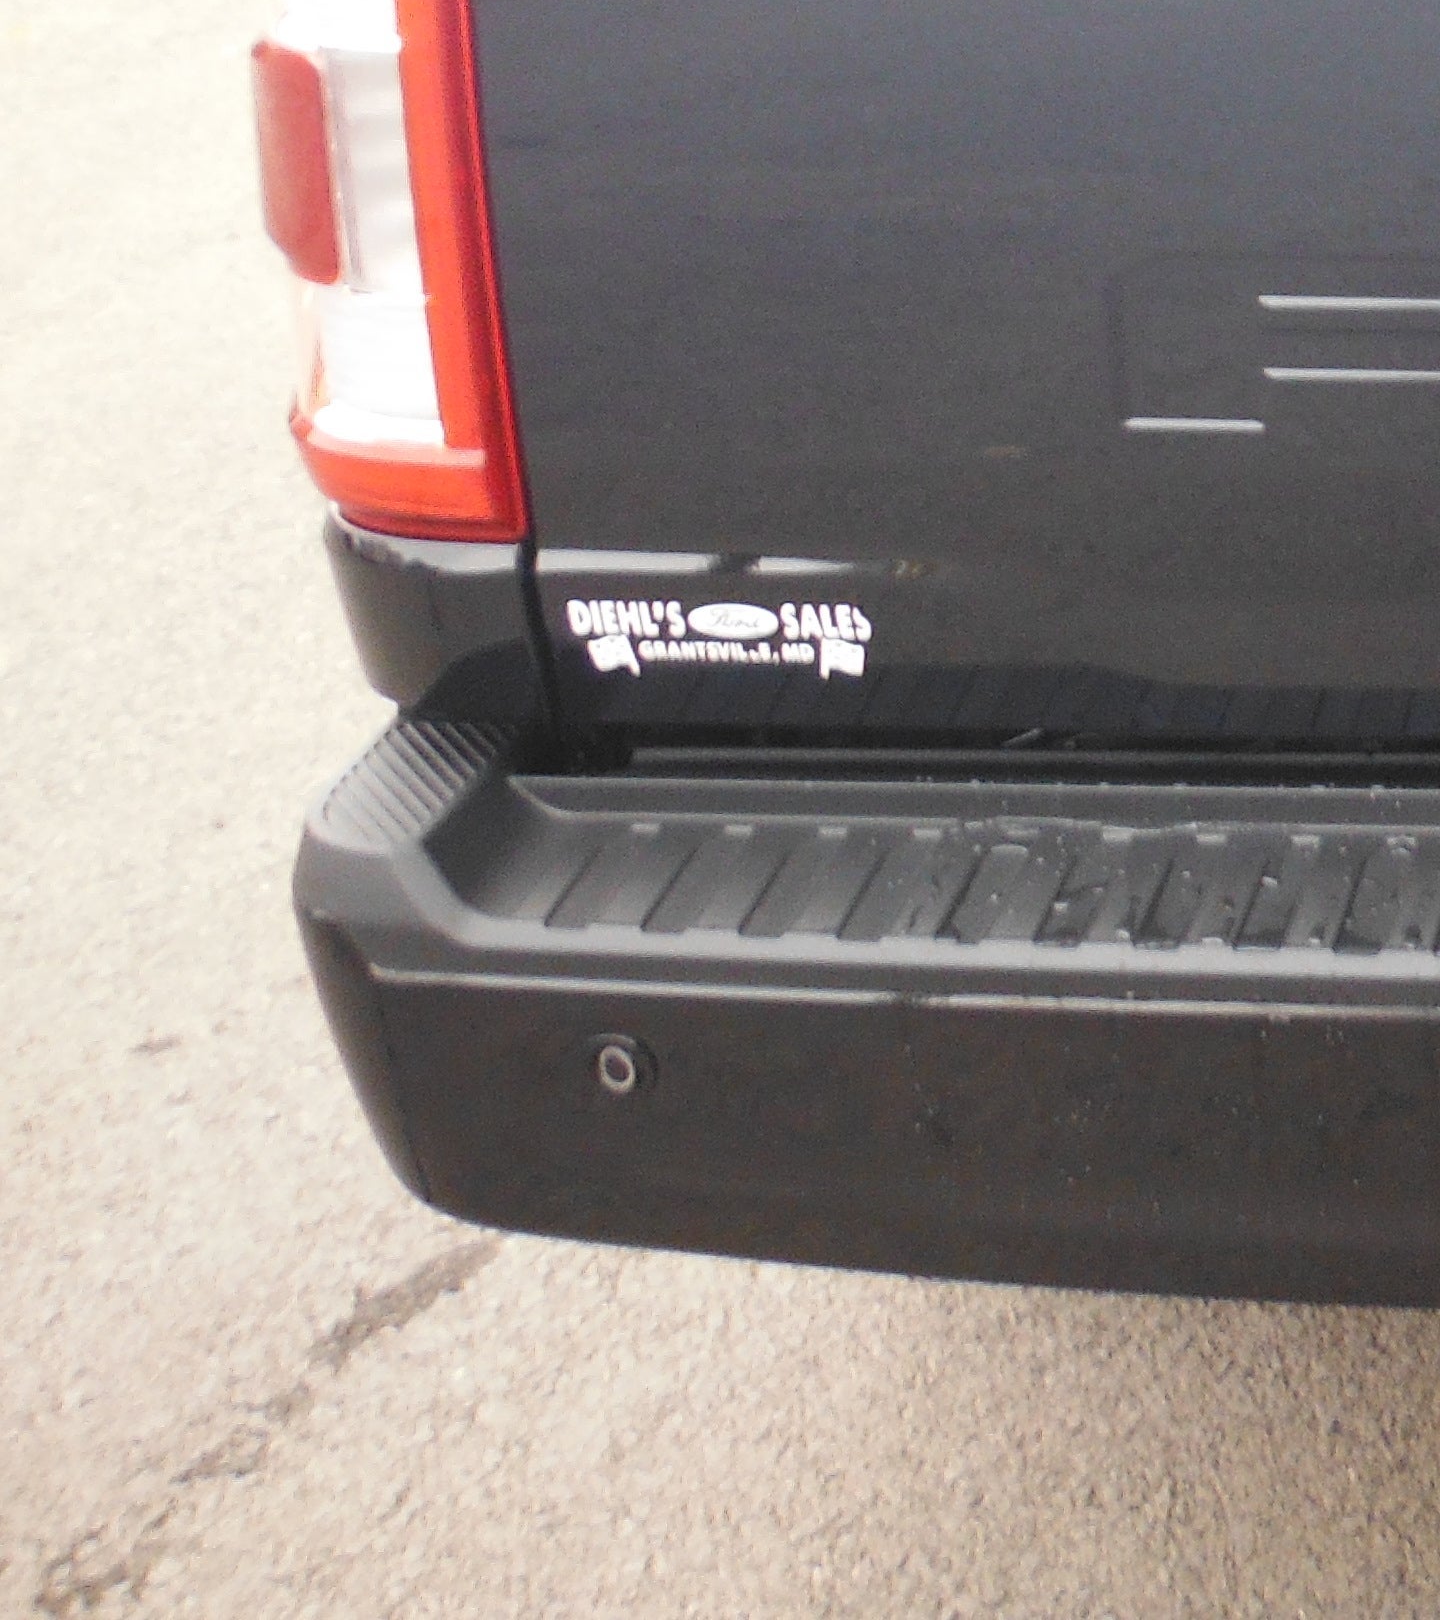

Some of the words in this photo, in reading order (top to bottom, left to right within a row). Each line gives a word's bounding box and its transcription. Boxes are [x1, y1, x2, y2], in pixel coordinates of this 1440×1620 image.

[567, 598, 686, 638] DIEHL'S
[780, 602, 872, 642] SALES
[782, 642, 815, 665] MD
